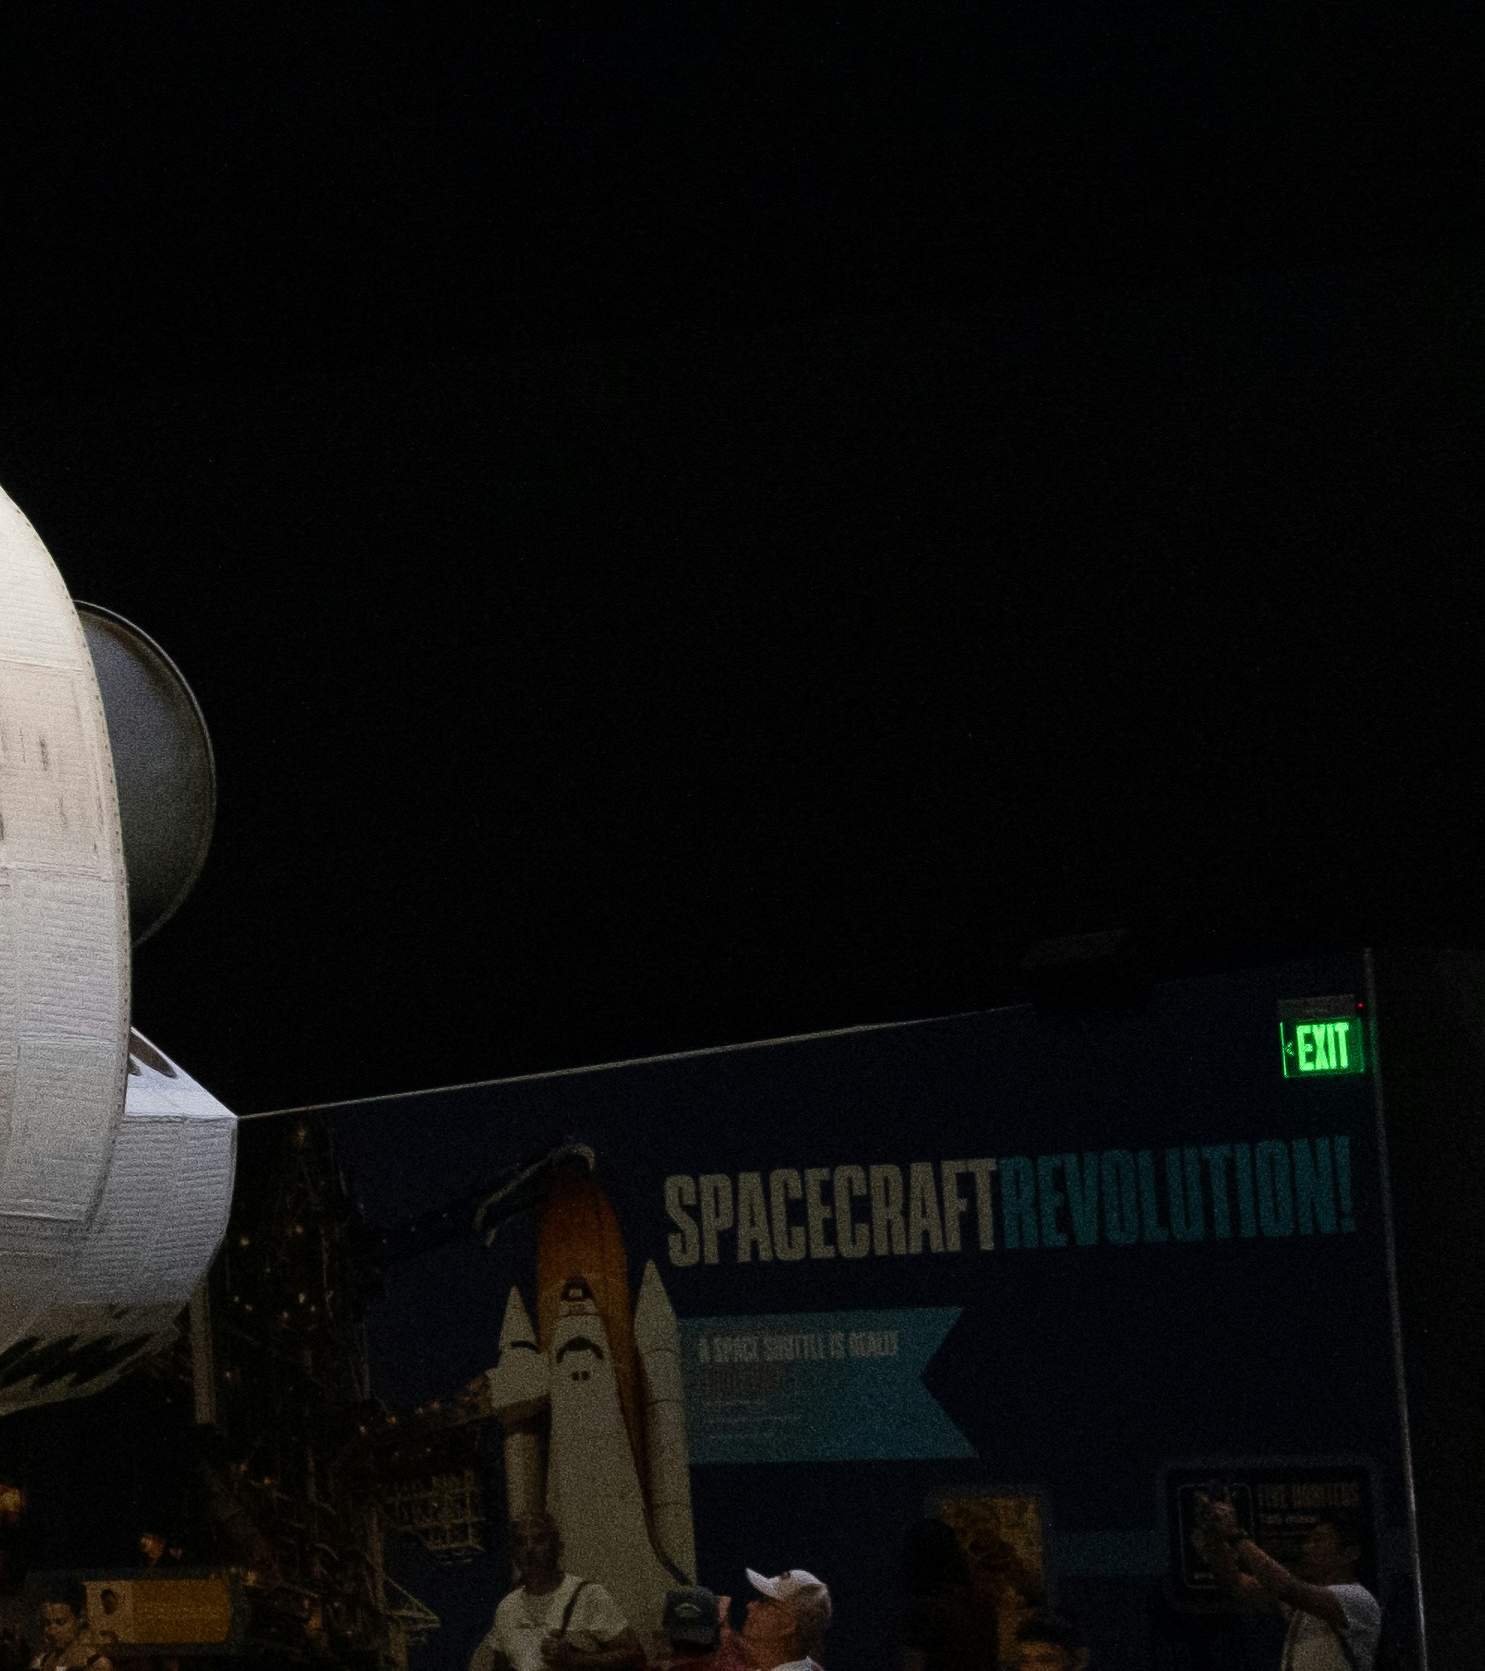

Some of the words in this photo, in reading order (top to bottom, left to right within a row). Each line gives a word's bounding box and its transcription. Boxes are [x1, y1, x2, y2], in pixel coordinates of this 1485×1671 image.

[1296, 1022, 1349, 1071] EXIT
[664, 1157, 997, 1267] SPACECRAFT
[998, 1135, 1356, 1250] REVOLUTION!
